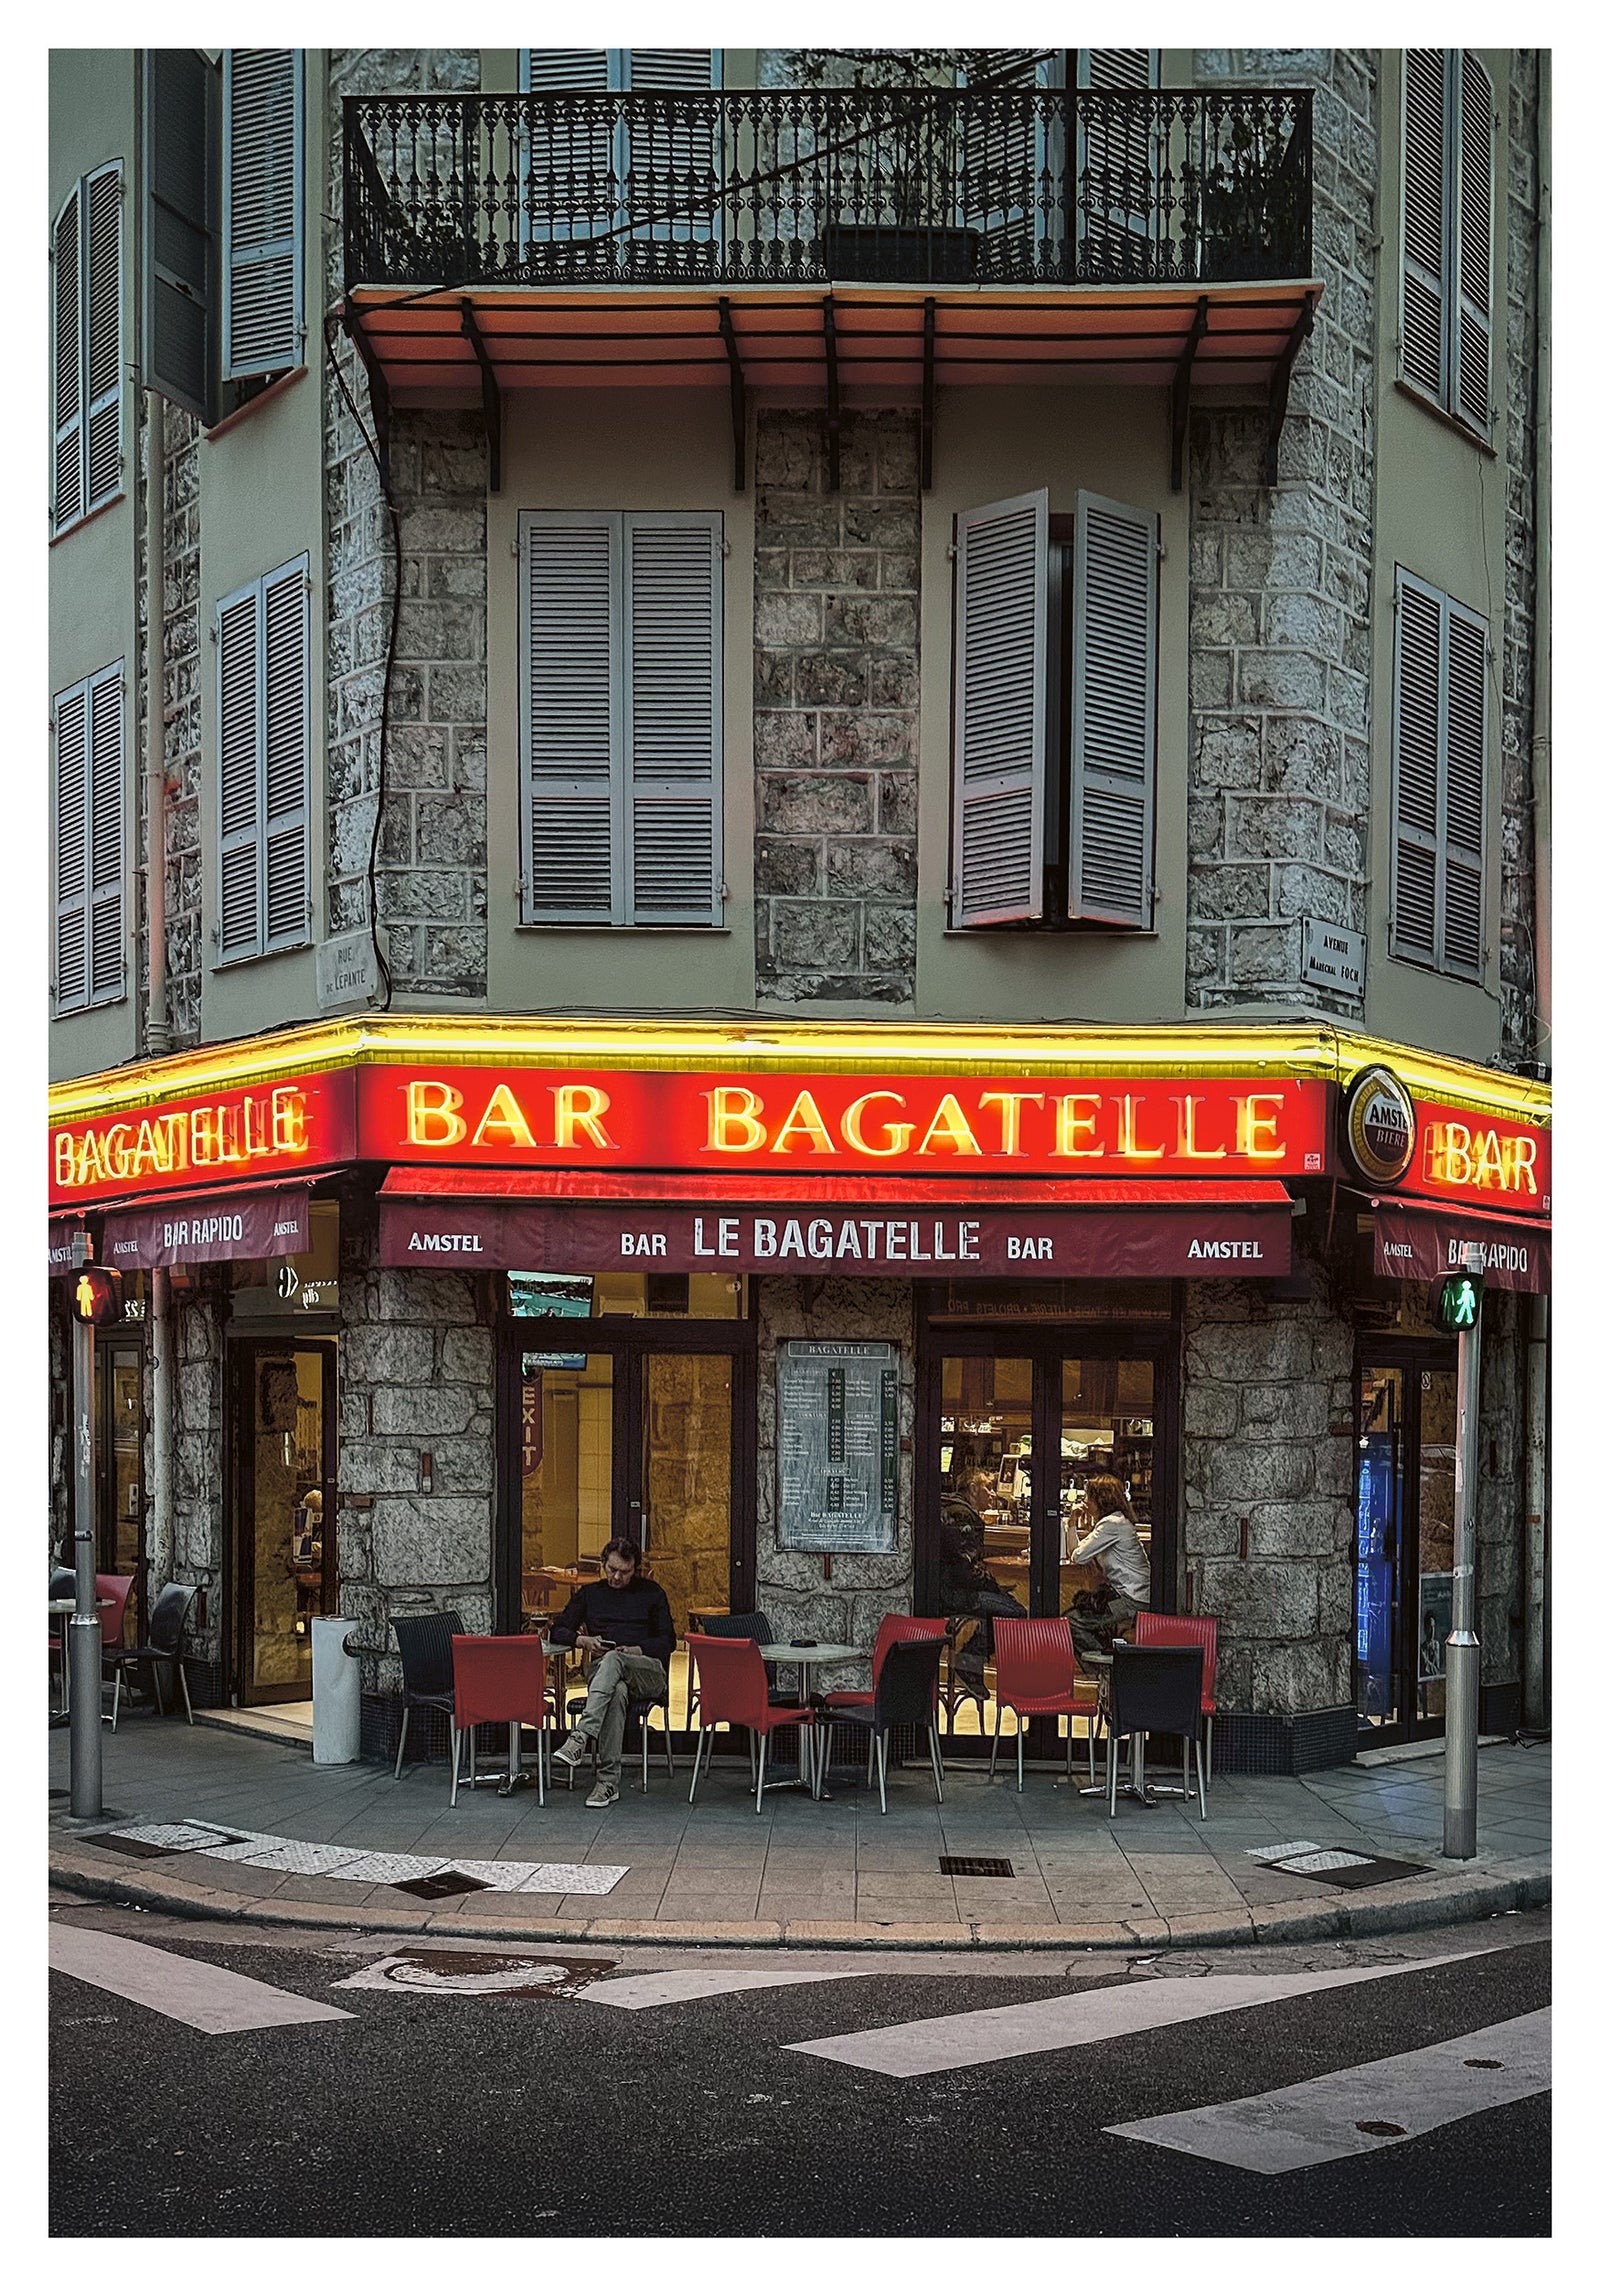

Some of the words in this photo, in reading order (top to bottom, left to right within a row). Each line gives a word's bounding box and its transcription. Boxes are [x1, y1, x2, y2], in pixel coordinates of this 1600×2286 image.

[337, 946, 353, 964] RUE
[1323, 935, 1349, 955] AVENUE
[1341, 965, 1359, 983] FOCH
[397, 1081, 620, 1149] BAR
[699, 1083, 1286, 1159] BAGATELLE
[55, 1086, 308, 1188] BAGATELLE
[1426, 1121, 1538, 1195] BAR
[164, 1220, 189, 1247] BAR
[191, 1214, 243, 1245] RAPIDO
[273, 1220, 298, 1236] AMSTEL
[113, 1240, 138, 1255] AMSTEL
[407, 1232, 483, 1252] AMSTEL
[621, 1233, 667, 1256] BAR
[694, 1218, 739, 1257] LE
[754, 1219, 980, 1260] BAGATELLE
[1007, 1236, 1053, 1260] BAR
[1187, 1238, 1263, 1259] AMSTEL
[1383, 1241, 1413, 1258] AMSTEL
[808, 1345, 871, 1355] BAGATELLE
[522, 1386, 537, 1466] EXIT
